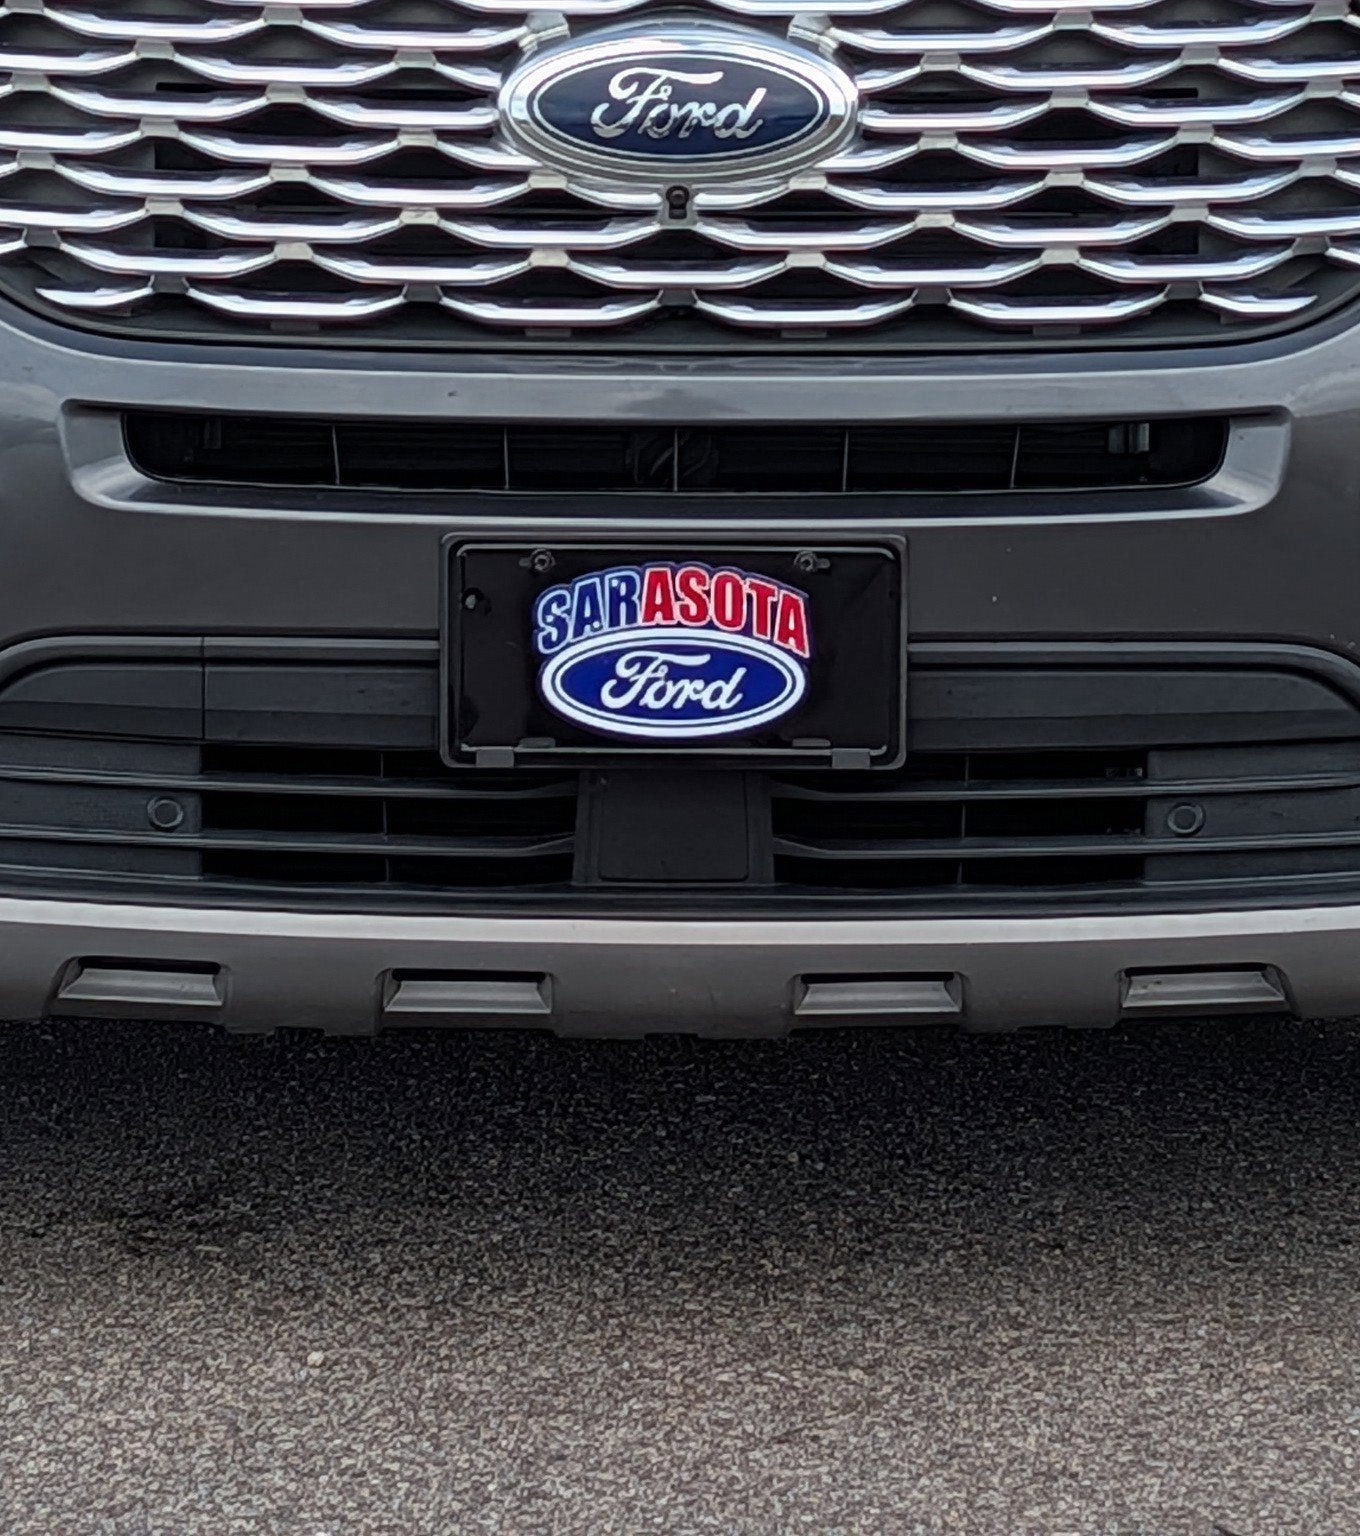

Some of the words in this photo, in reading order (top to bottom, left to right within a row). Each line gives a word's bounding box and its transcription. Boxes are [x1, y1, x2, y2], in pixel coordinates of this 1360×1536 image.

[591, 66, 767, 139] Ford
[537, 566, 811, 659] SARASOTA
[600, 650, 747, 710] Ford
